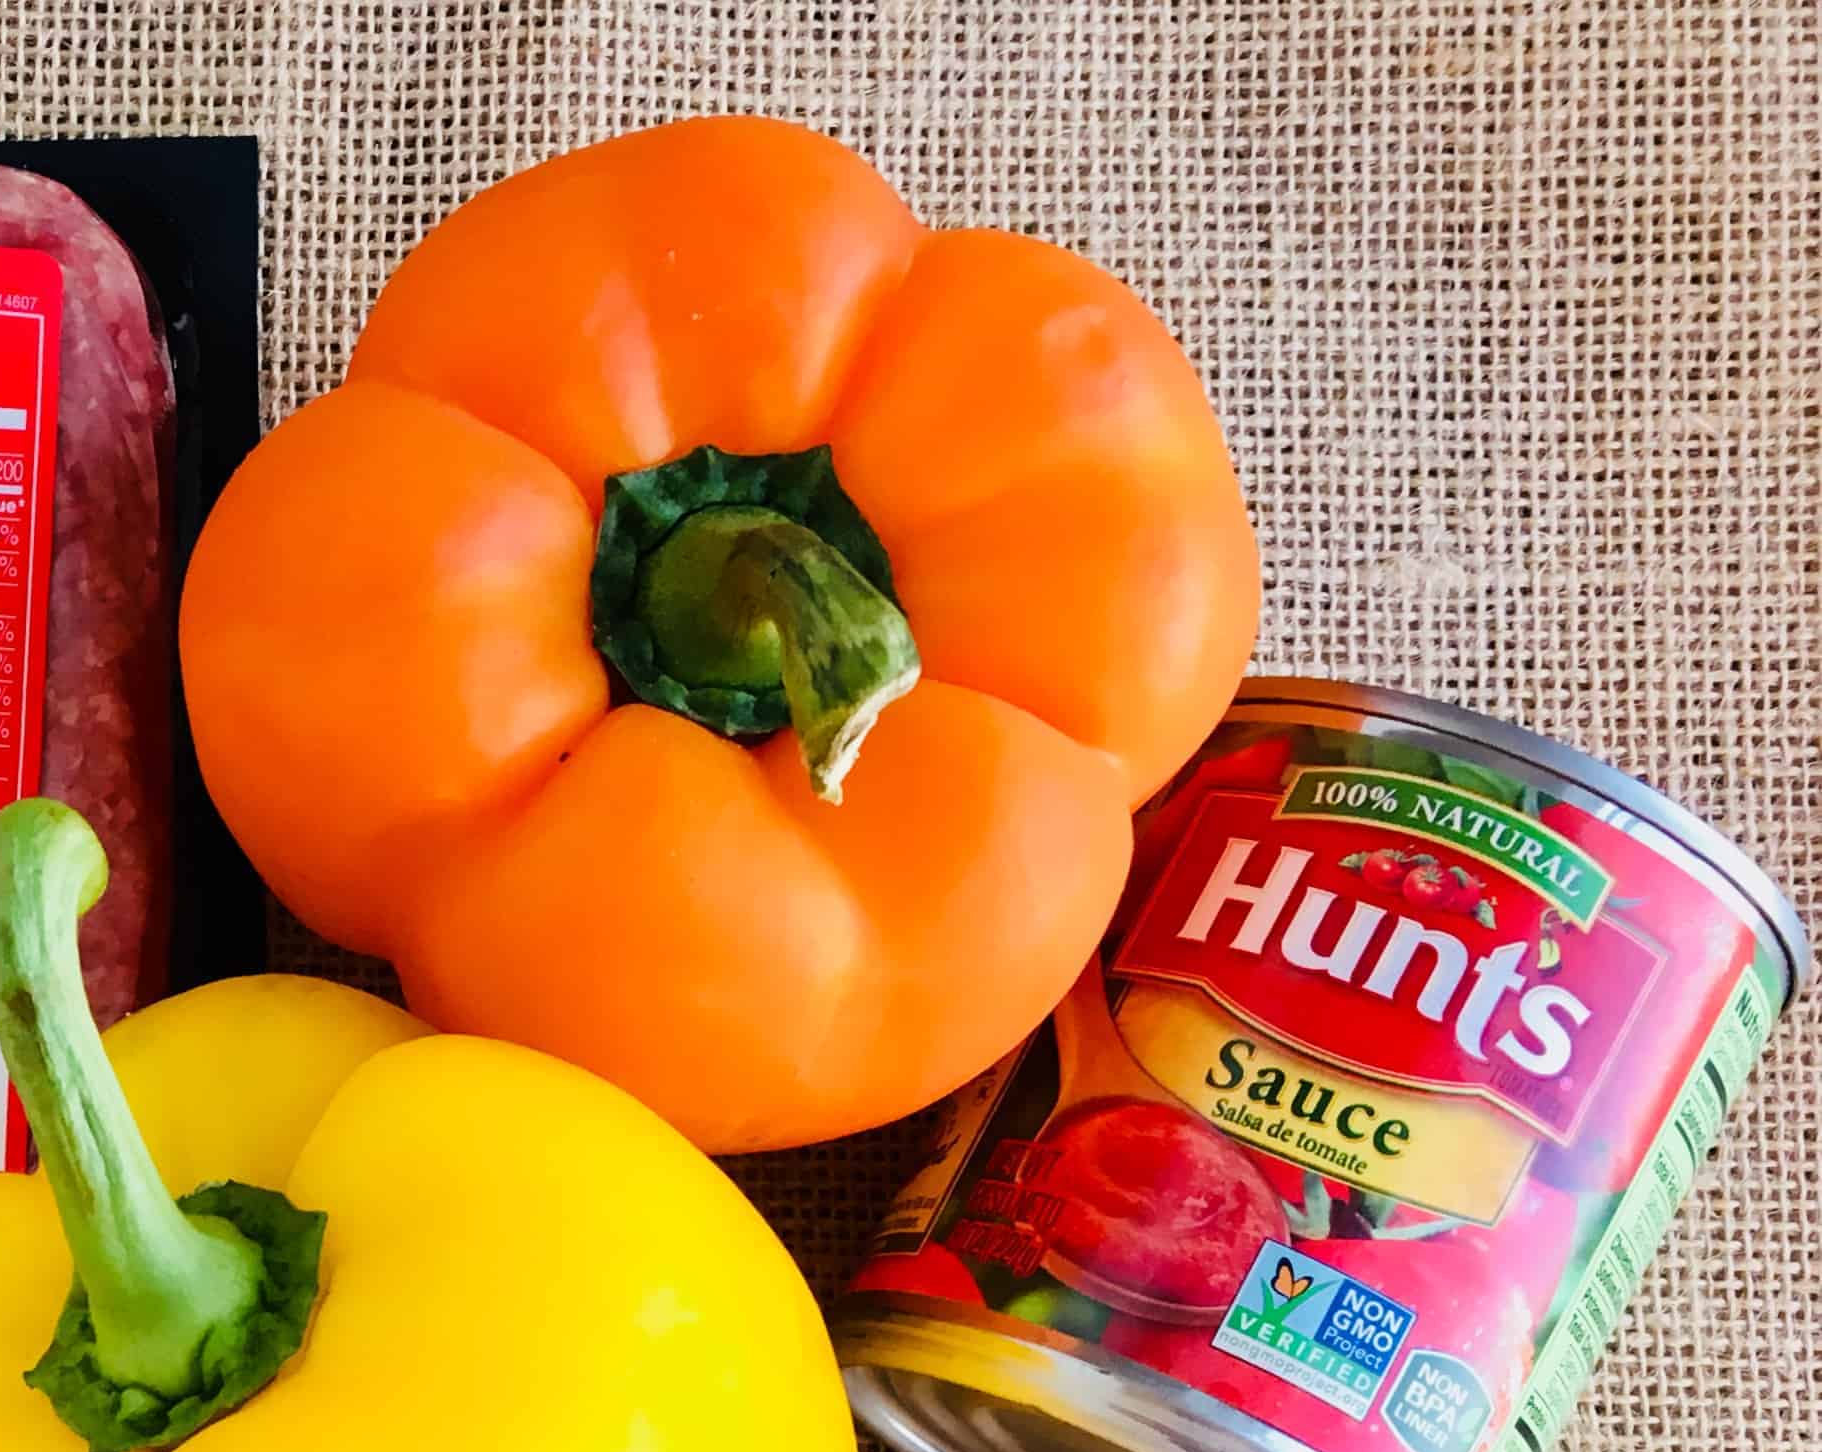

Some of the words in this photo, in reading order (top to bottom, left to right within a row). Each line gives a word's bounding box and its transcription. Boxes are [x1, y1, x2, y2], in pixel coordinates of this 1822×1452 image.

[1311, 780, 1398, 814] 100%
[1407, 793, 1584, 900] NATURAL
[1205, 1038, 1410, 1156] Sauce
[1212, 1098, 1263, 1132] Salsa
[1267, 1119, 1292, 1143] de
[1296, 1132, 1368, 1176] tomate
[1332, 1310, 1393, 1352] GMO
[1342, 1289, 1404, 1334] NON
[1239, 1312, 1371, 1392] VERIFIED
[1322, 1328, 1384, 1369] Project
[1405, 1381, 1457, 1431] BPA
[1418, 1363, 1469, 1406] NON
[1393, 1402, 1449, 1448] LINER
